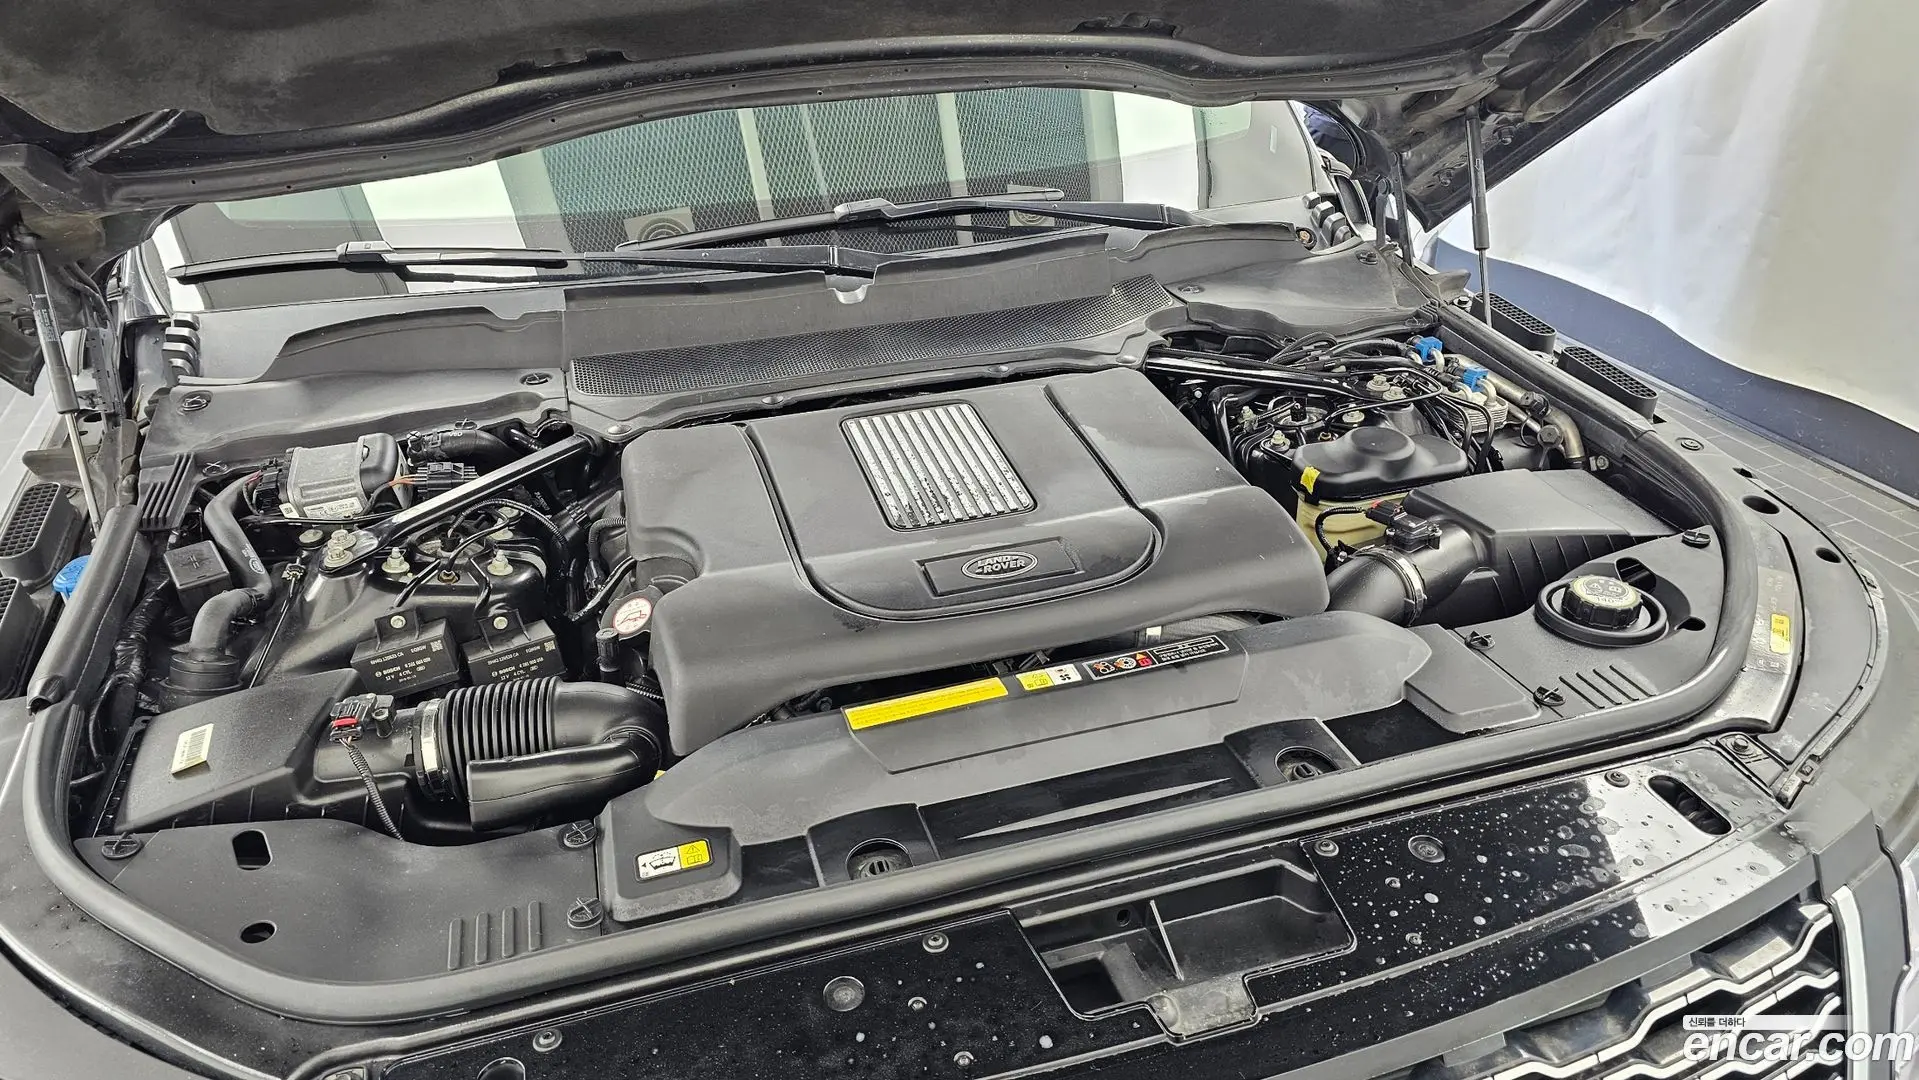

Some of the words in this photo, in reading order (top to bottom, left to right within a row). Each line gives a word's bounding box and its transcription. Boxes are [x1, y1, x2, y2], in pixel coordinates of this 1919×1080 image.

[977, 555, 1014, 565] LAND
[982, 559, 1026, 574] ROVER
[382, 665, 401, 675] BOSCH
[498, 665, 516, 675] BOSCH
